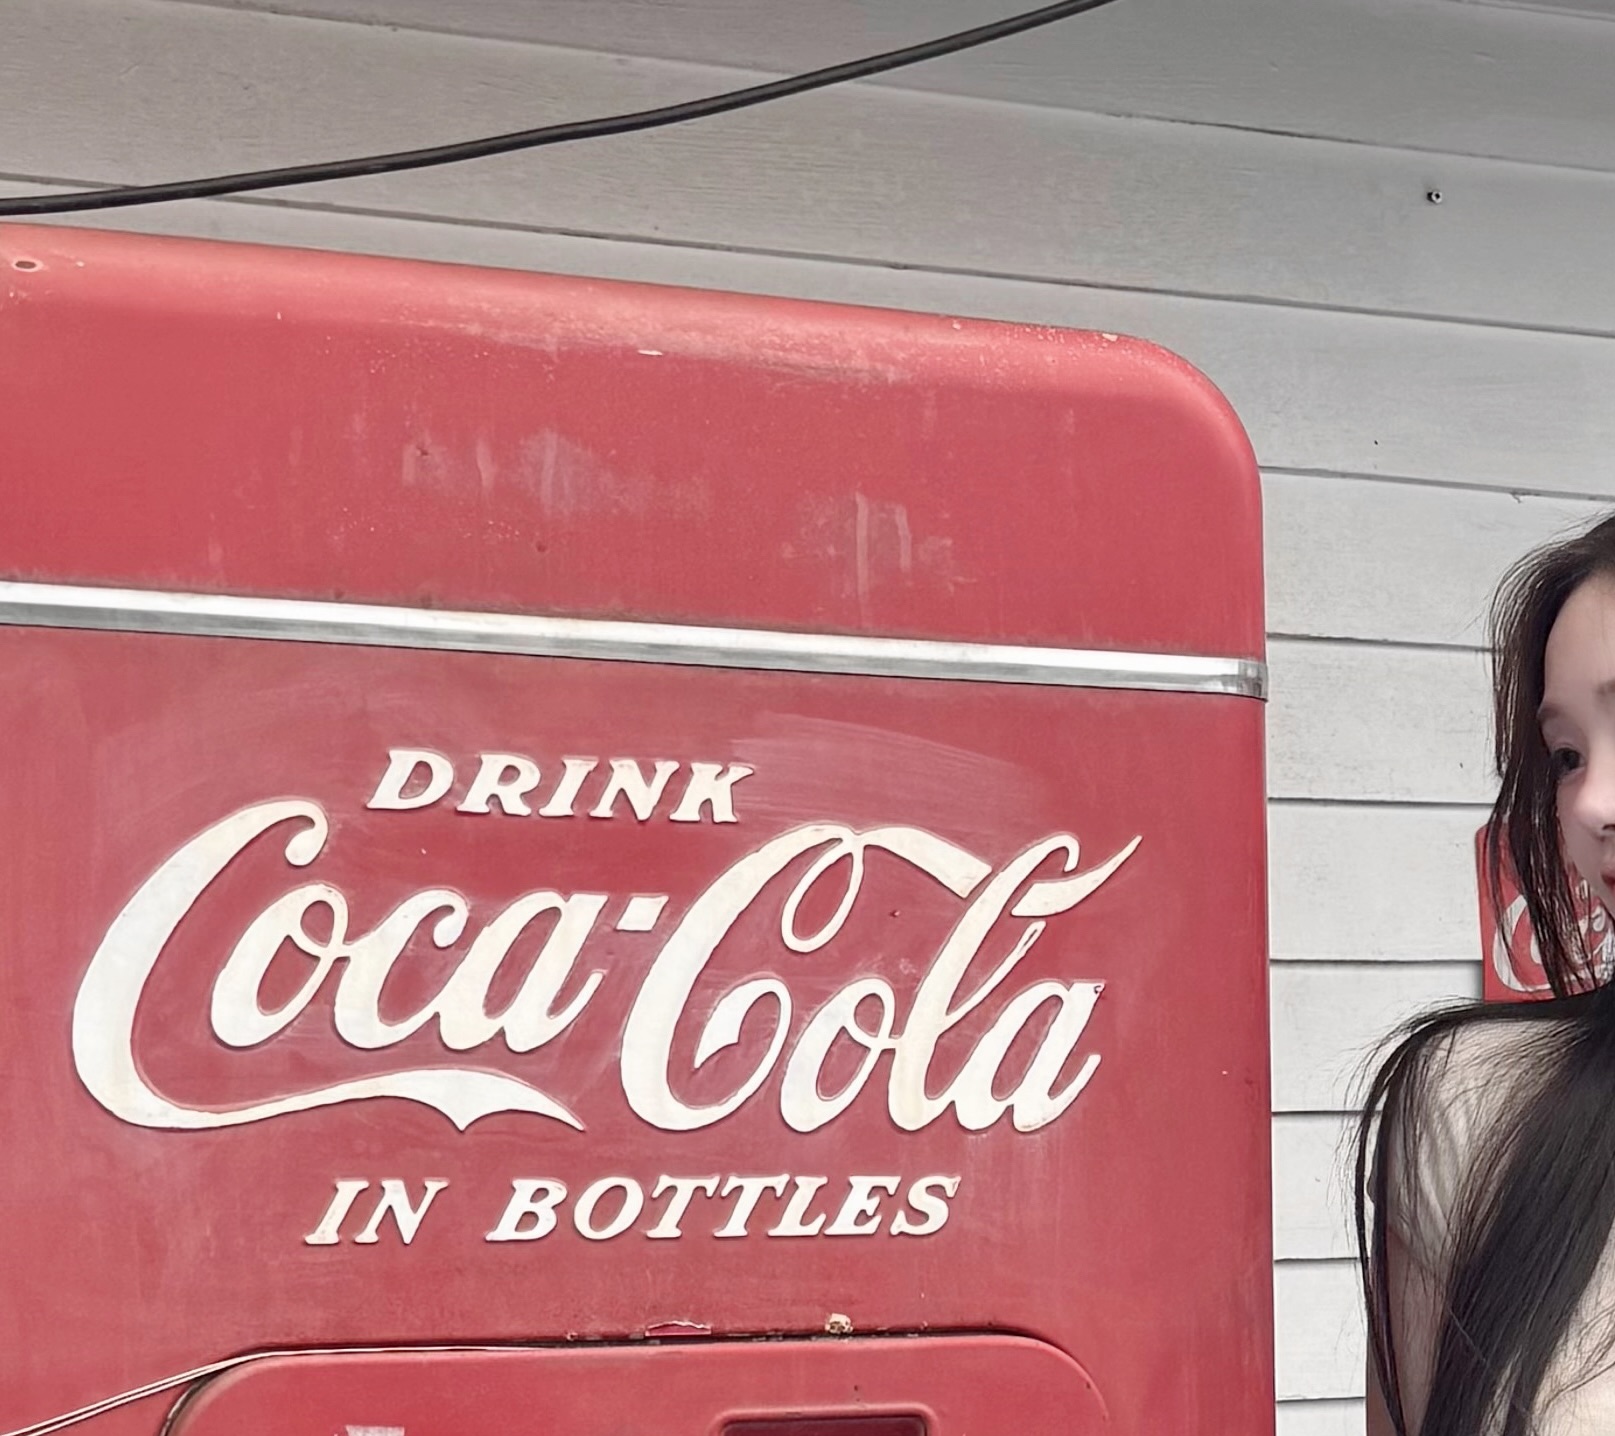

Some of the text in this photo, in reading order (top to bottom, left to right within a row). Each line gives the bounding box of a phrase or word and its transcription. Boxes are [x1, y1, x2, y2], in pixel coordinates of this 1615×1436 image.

[366, 747, 760, 825] DRINK
[71, 798, 1144, 1133] Coca-Cola
[303, 1173, 963, 1246] IN BOTTLES
